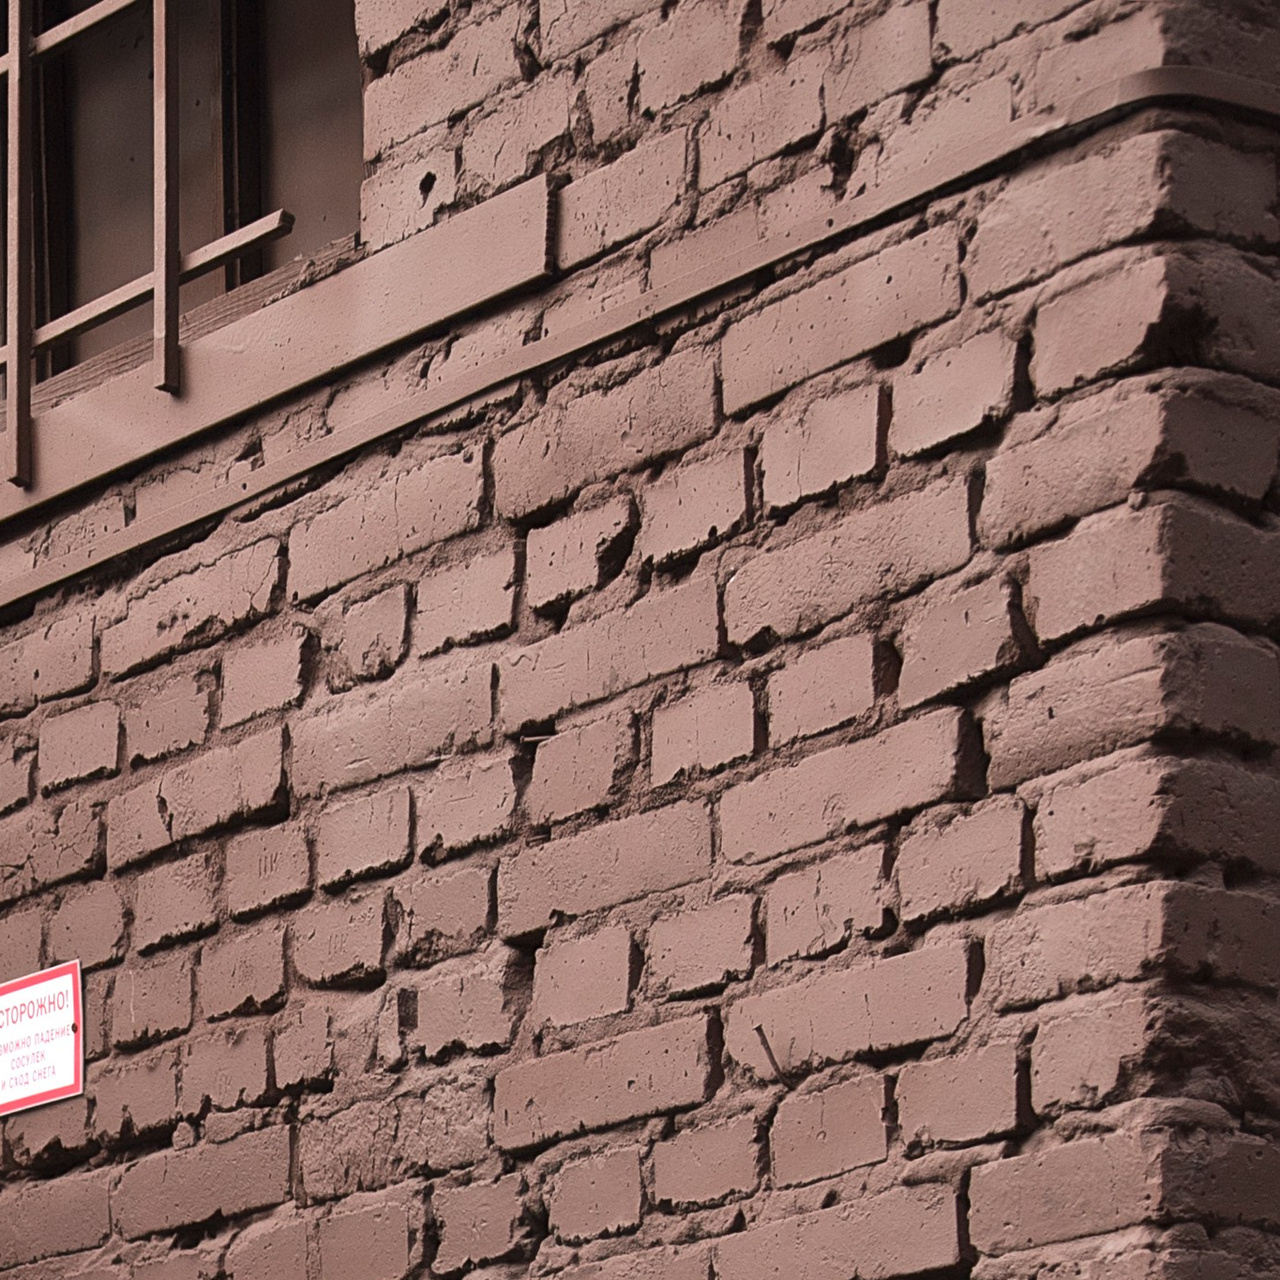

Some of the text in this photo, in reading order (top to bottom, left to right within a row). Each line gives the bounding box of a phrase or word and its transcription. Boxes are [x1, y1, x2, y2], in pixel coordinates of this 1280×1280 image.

[34, 1024, 70, 1046] ПАДЕНИЕ
[10, 1050, 46, 1070] СОСУЛЕК
[1, 1065, 56, 1091] И СХОД СНЕГА
